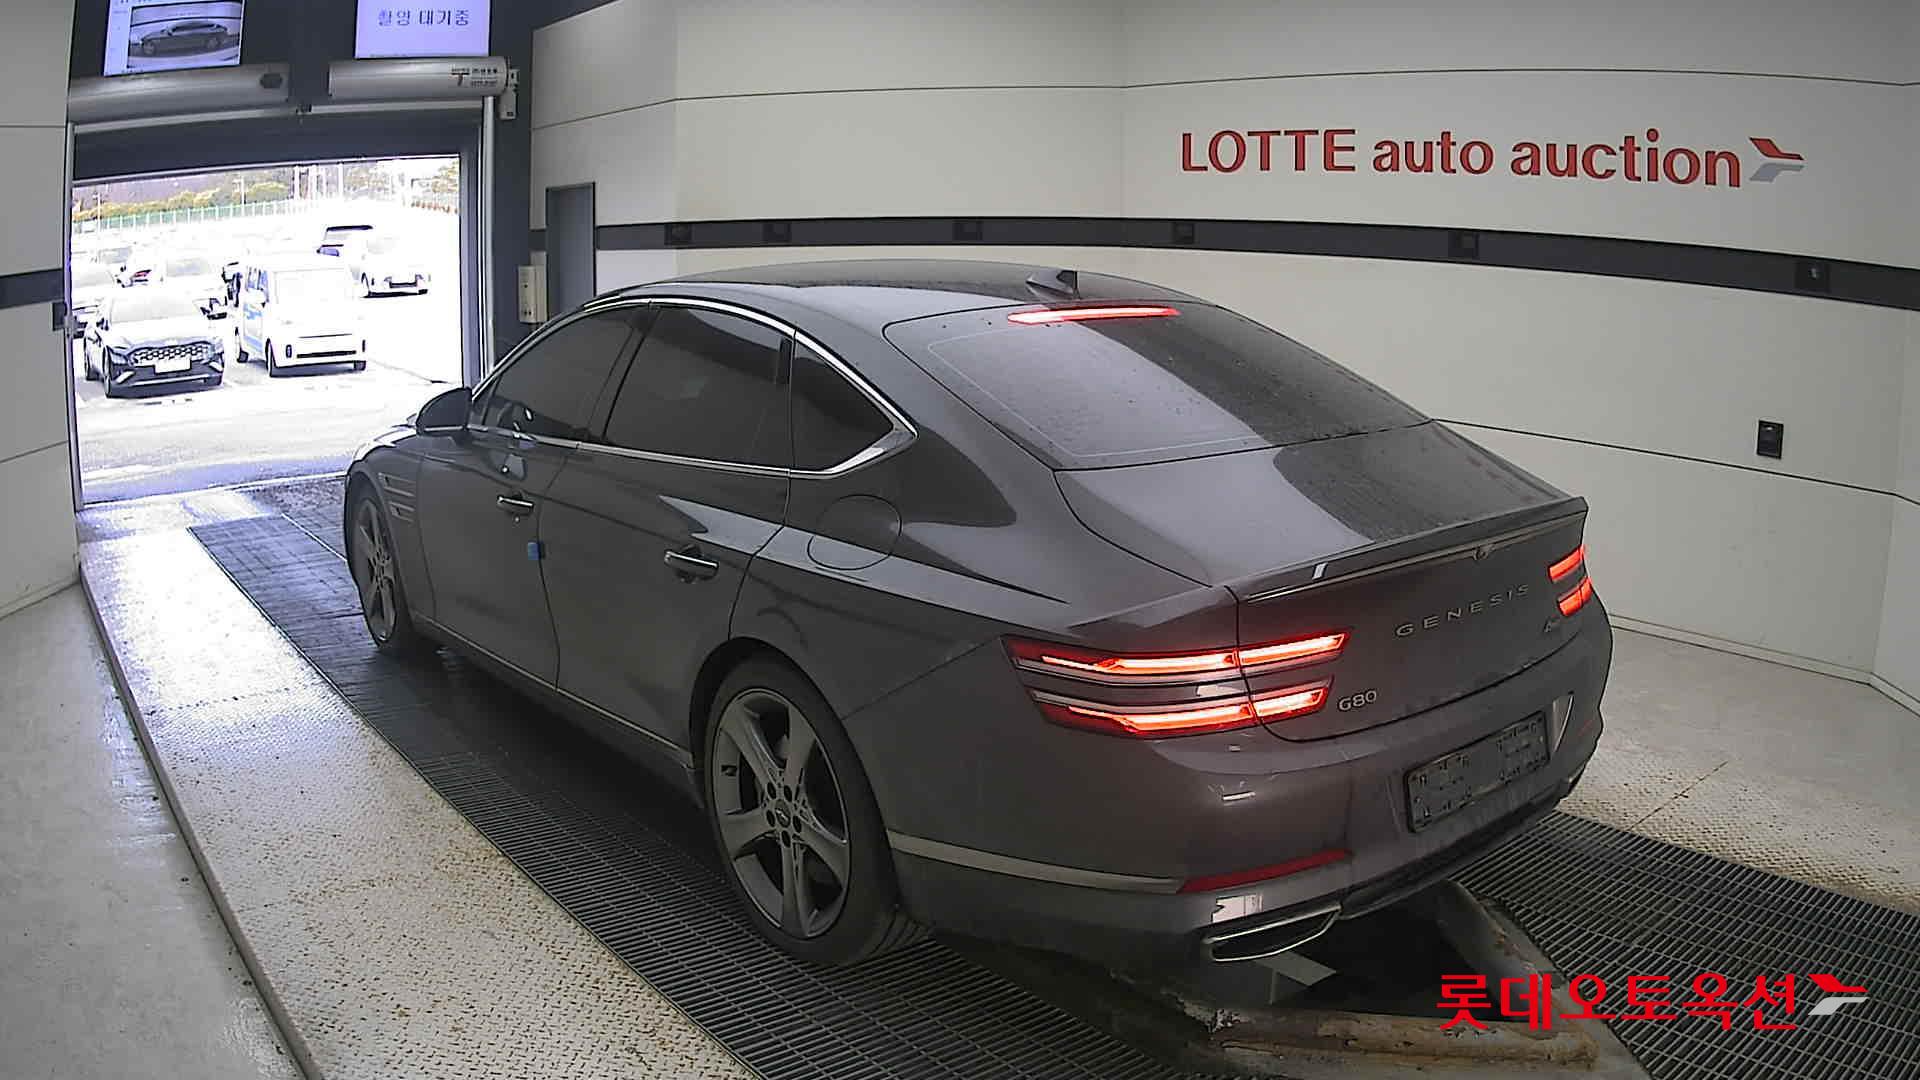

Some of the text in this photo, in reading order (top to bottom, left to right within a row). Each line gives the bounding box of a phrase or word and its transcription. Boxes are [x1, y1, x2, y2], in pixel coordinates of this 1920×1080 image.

[419, 9, 469, 27] 대기중
[1181, 128, 1742, 188] LOTTE auto auction
[1395, 583, 1530, 637] GENESIS
[1338, 690, 1378, 711] G80
